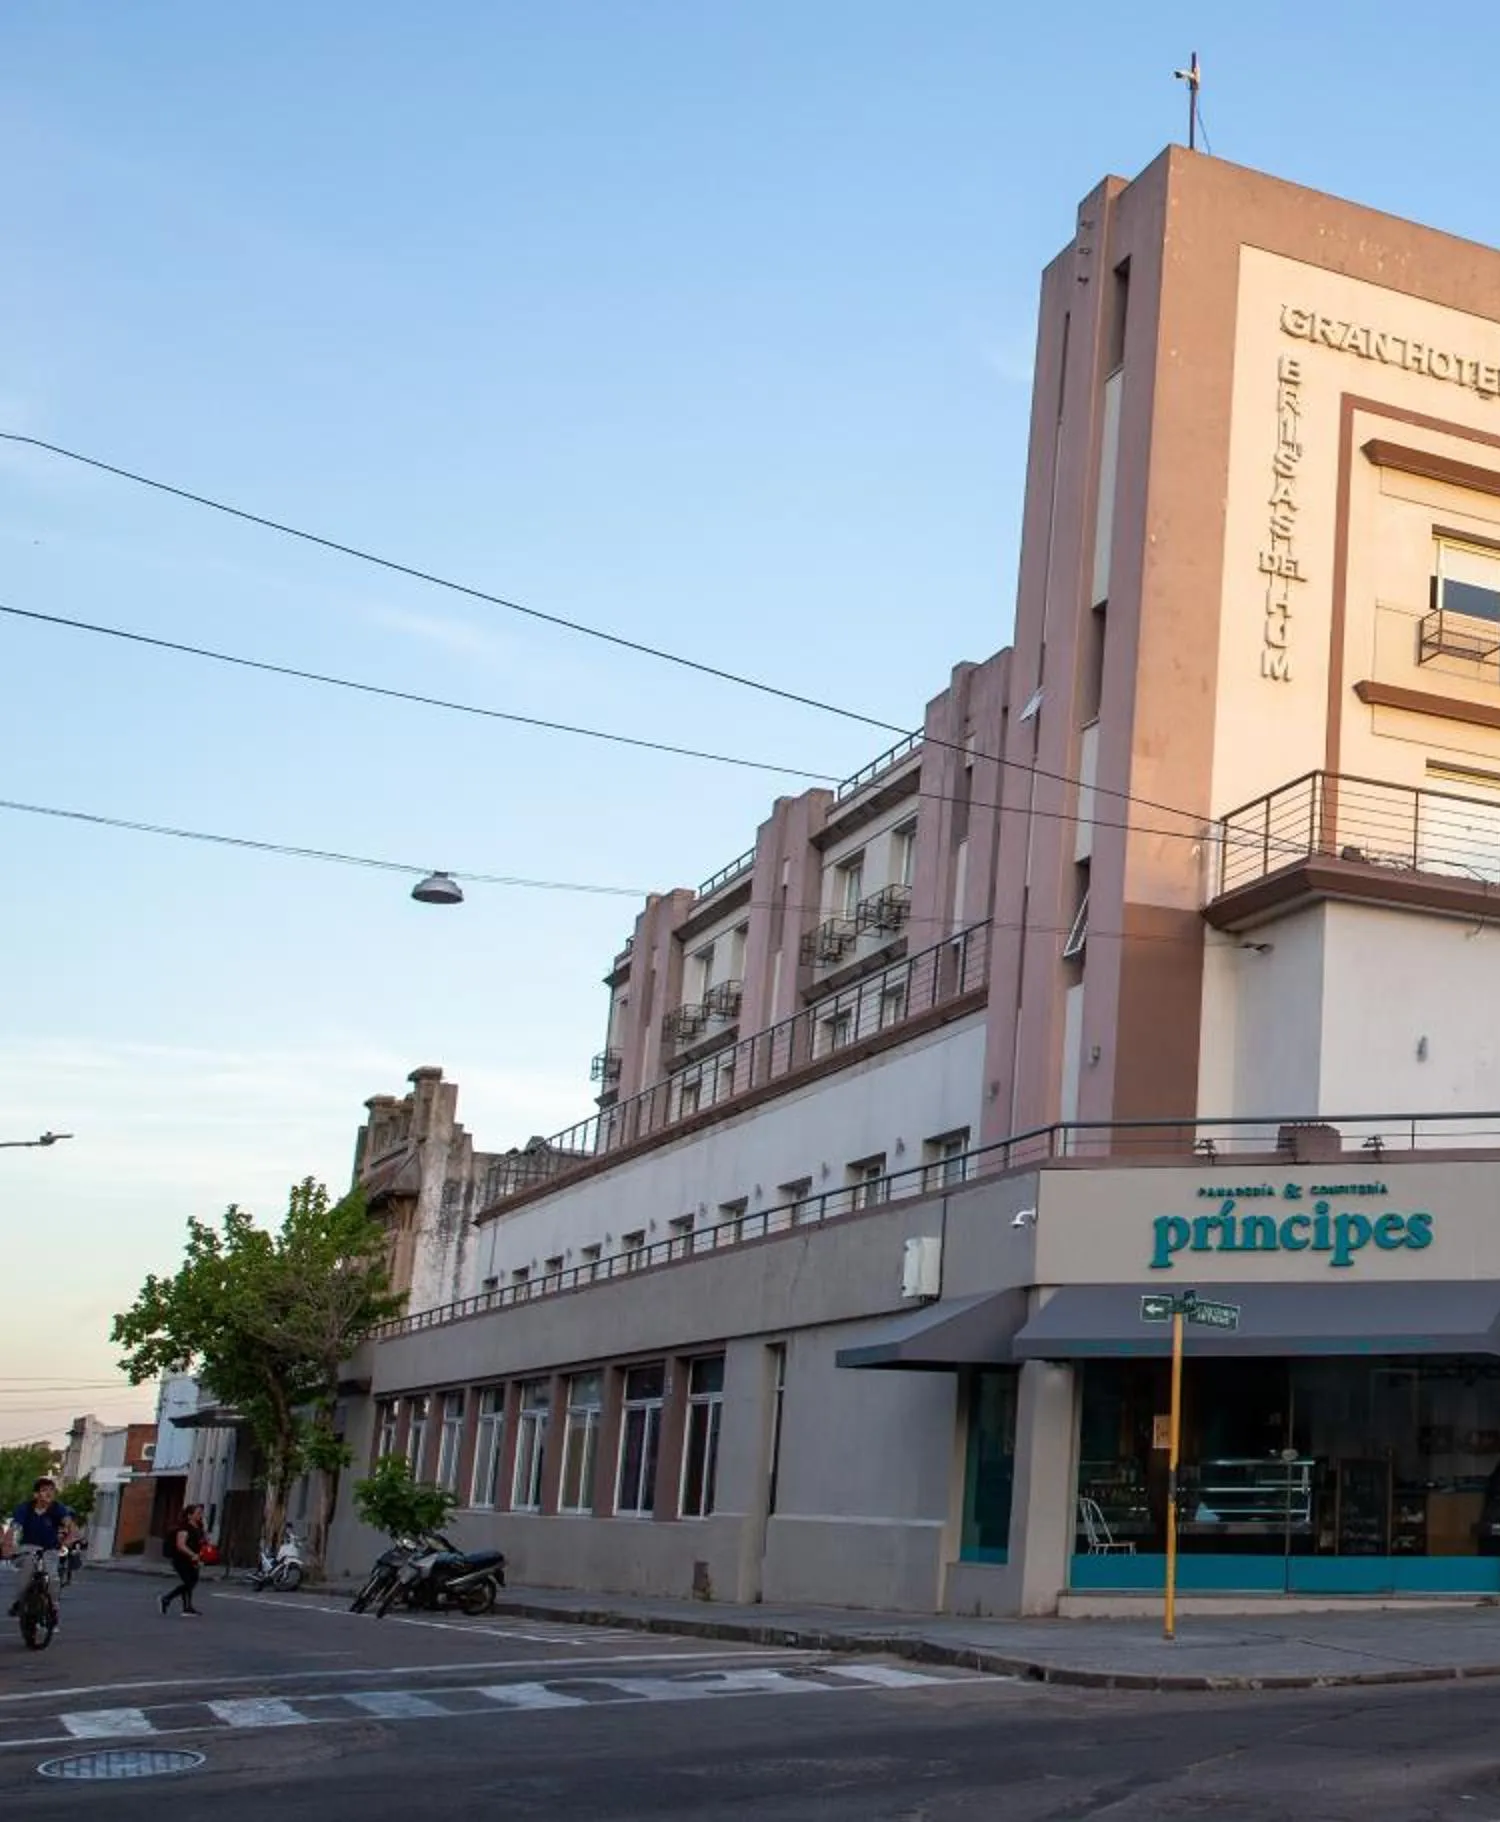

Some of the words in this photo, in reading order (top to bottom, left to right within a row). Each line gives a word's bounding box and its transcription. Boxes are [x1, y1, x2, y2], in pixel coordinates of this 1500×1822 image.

[1280, 304, 1391, 364] GRAN
[1268, 354, 1303, 546] BRISAS
[1260, 577, 1293, 683] HUM
[1149, 1200, 1433, 1268] príncipes
